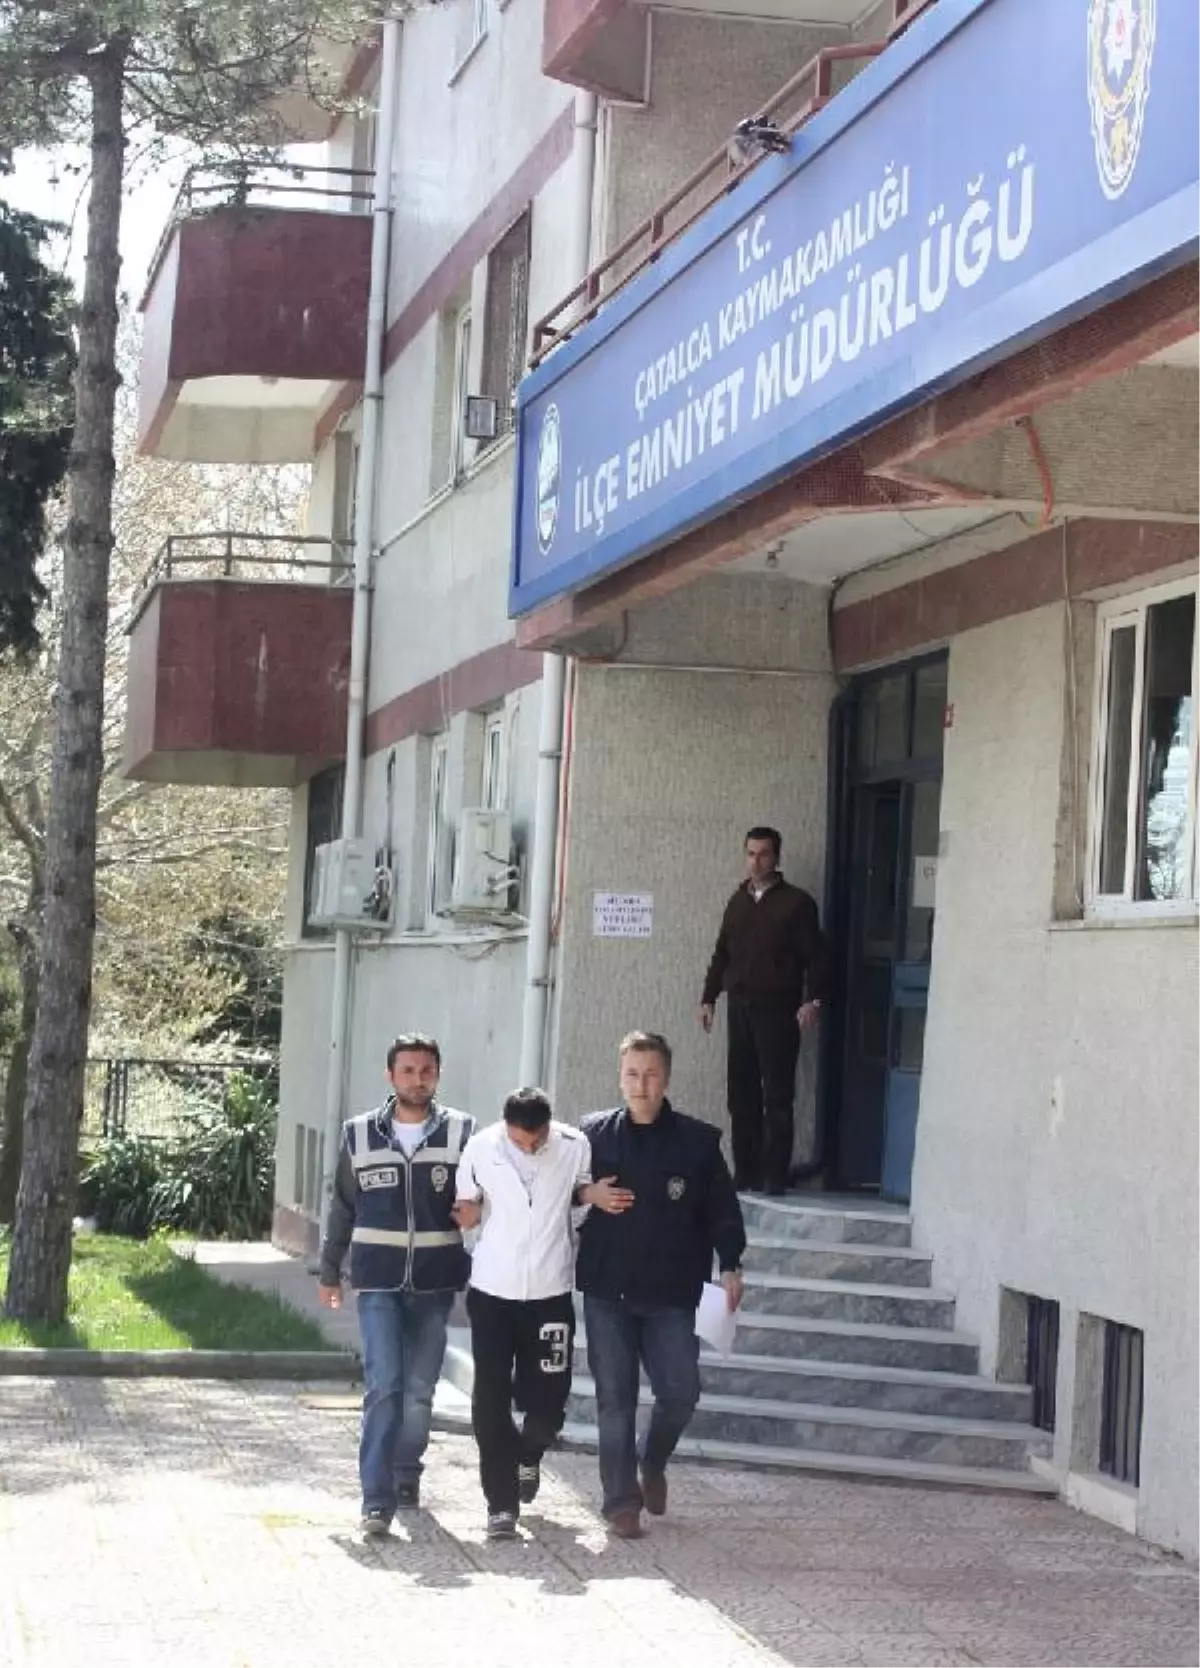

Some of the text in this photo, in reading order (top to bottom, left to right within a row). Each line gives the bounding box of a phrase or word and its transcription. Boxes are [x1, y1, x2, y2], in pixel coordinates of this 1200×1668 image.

[634, 160, 909, 421] ÇATALCA KAYMAKAMLIĞI
[736, 215, 772, 272] T.C.
[574, 144, 1034, 536] İLÇE EMNİYET MÜDÜRLÜĞÜ
[539, 1323, 569, 1372] 3
